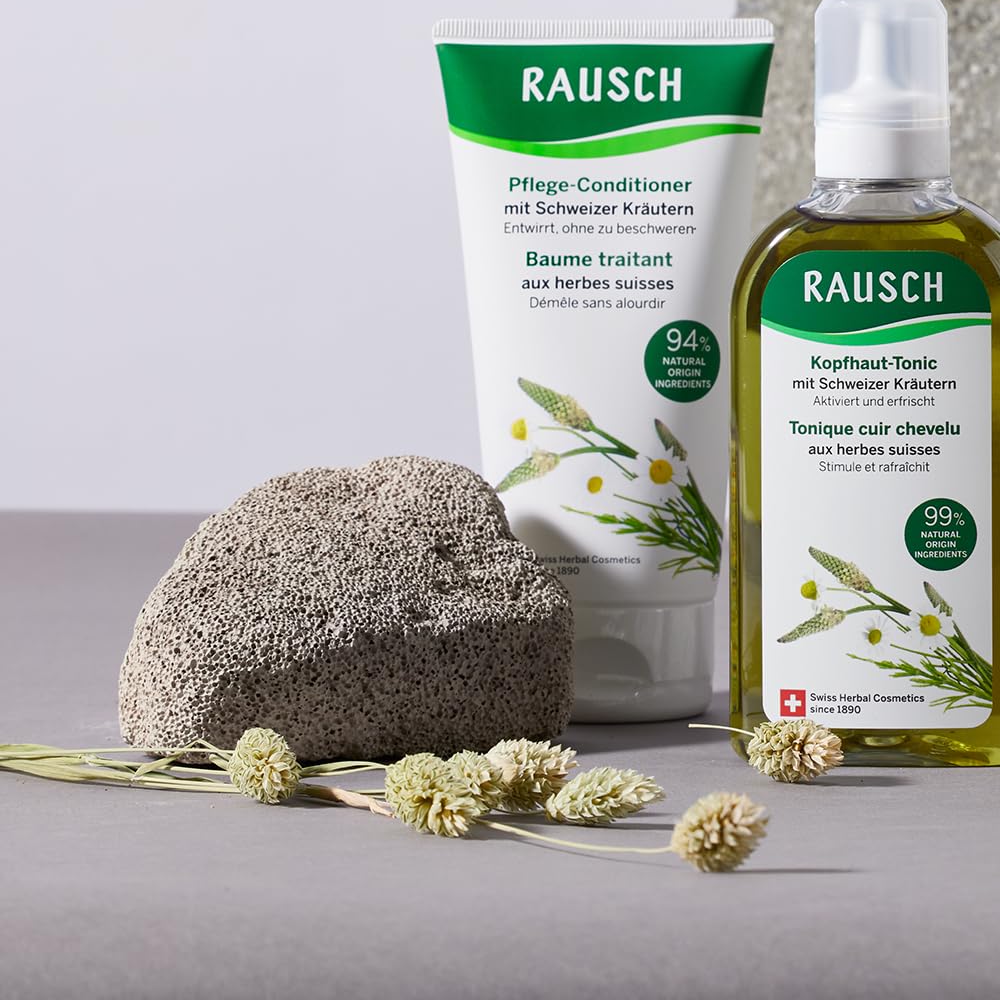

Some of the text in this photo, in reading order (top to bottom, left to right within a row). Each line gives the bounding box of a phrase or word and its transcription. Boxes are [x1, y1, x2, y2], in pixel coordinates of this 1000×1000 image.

[522, 67, 682, 102] RAUSCH
[509, 177, 693, 196] Pflege-Conditioner
[504, 201, 694, 216] mit Schweizer Kräutern
[504, 222, 559, 235] Entwirrt,
[562, 222, 595, 234] ohne
[598, 224, 614, 234] zu
[526, 251, 673, 267] Baume traitant
[521, 276, 675, 290] aux herbes suisses
[803, 270, 943, 303] RAUSCH
[529, 297, 666, 309] Démêle sans alourdir
[666, 327, 711, 352] 94%
[662, 357, 706, 366] NATURAL
[810, 356, 938, 373] Kopfhaut-Tonic
[667, 368, 701, 377] ORIGIN
[655, 379, 712, 388] INGREDIENTS
[792, 377, 957, 390] mit Schweizer Kräutern
[813, 396, 935, 407] Aktiviert und erfrischt
[789, 420, 961, 439] Tonique cuir chevelu
[808, 443, 941, 456] aux herbes suisses
[819, 461, 930, 473] Stimule et rafraîchit
[924, 506, 965, 526] 99%
[921, 530, 961, 539] NATURAL
[925, 540, 957, 549] ORIGIN
[536, 555, 641, 565] wiss Herbal Cosmetics
[914, 550, 968, 559] INGREDIENTS
[557, 566, 580, 576] 1890
[810, 693, 925, 703] Swiss Herbal Cosmetics
[810, 705, 861, 714] since 1890
